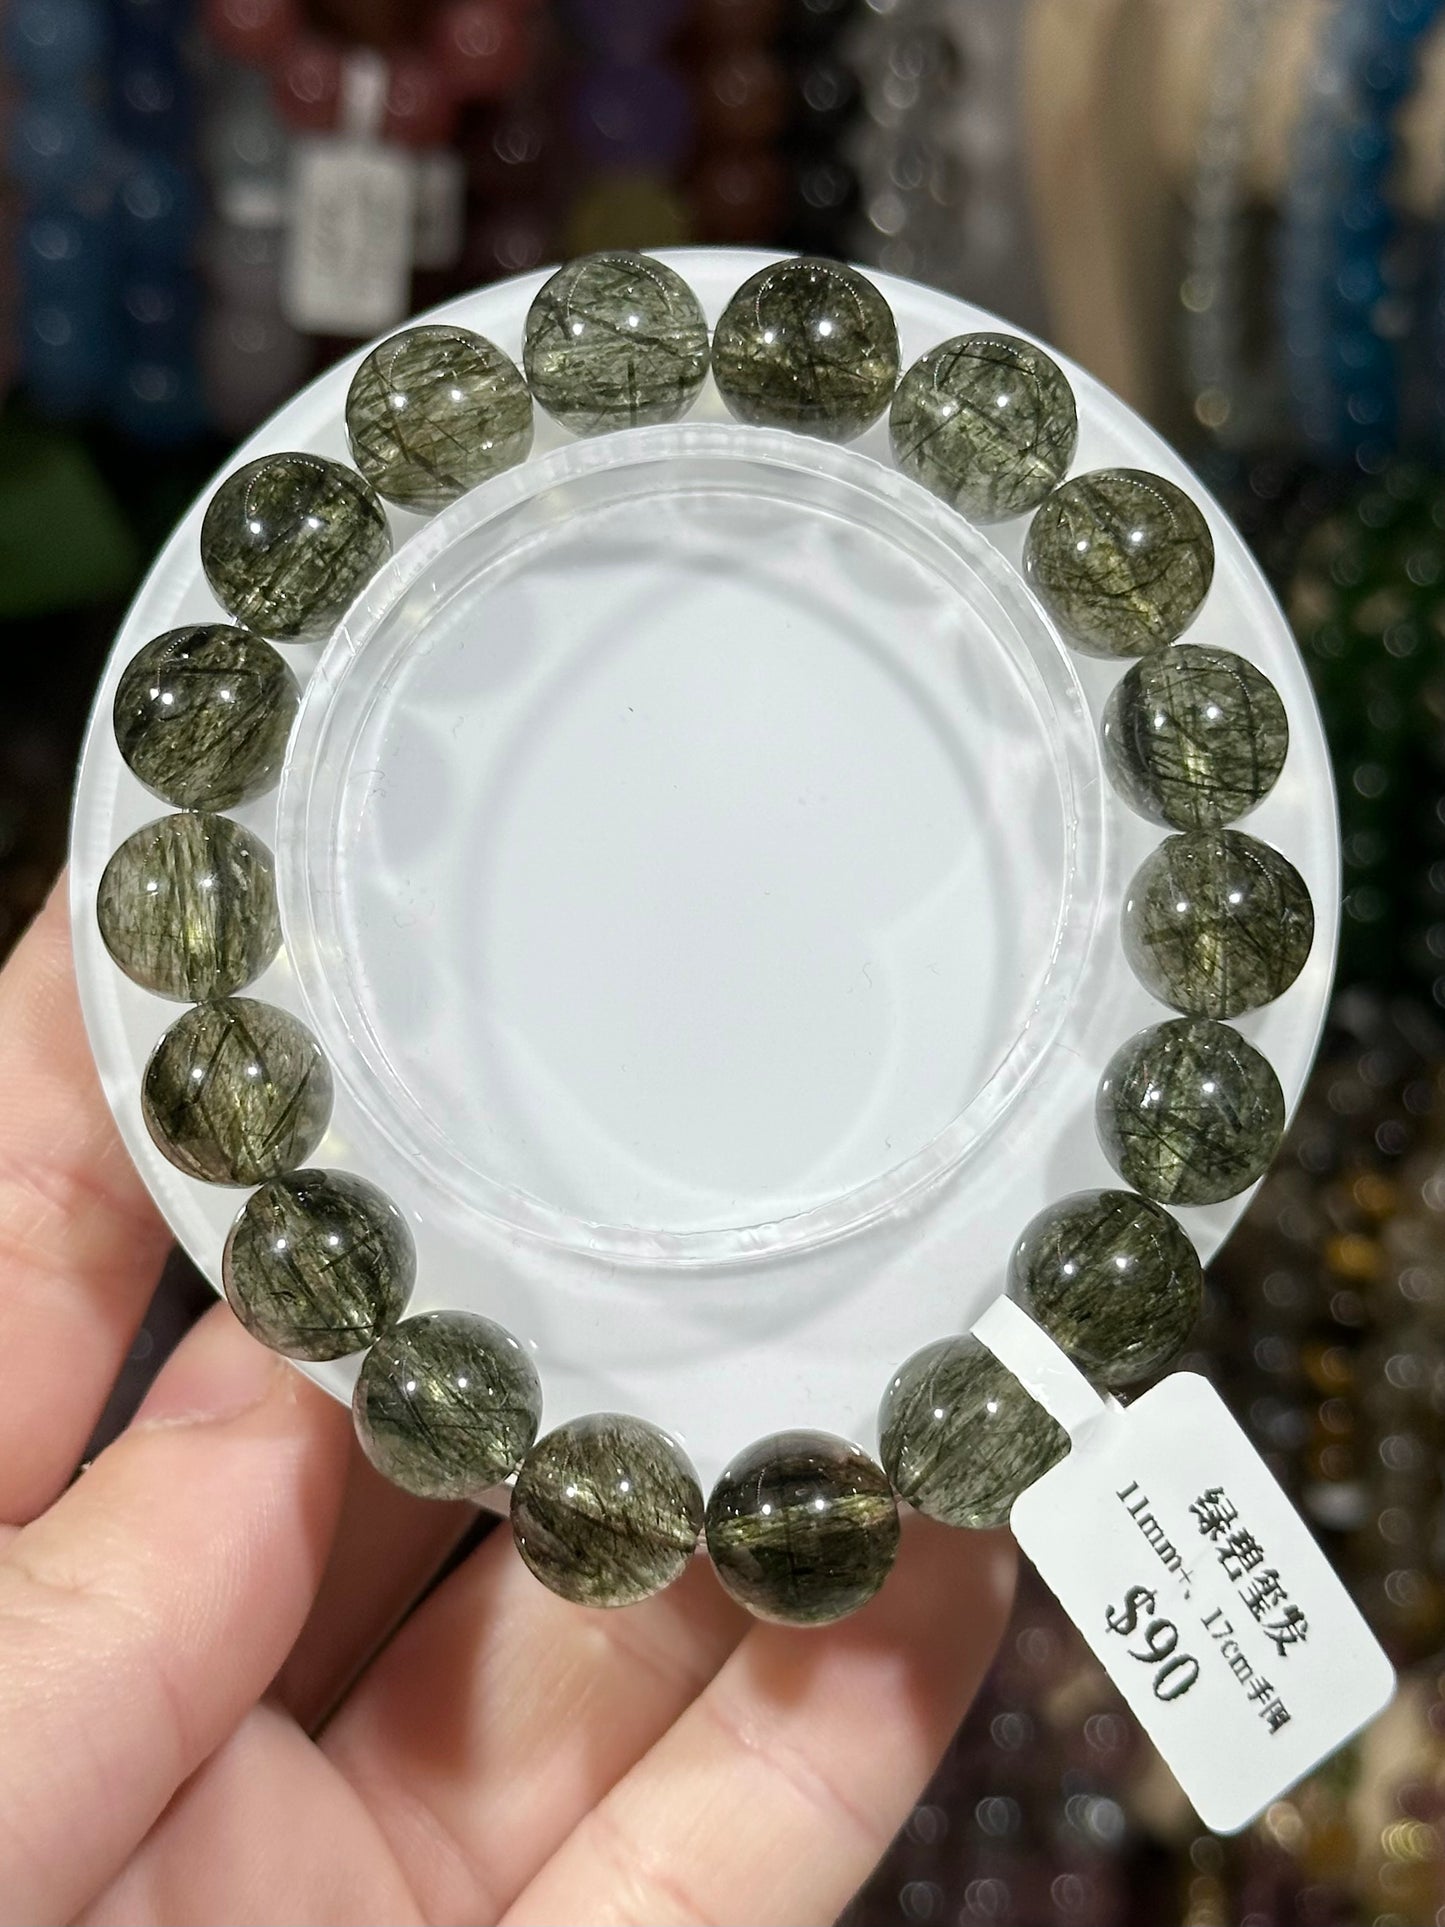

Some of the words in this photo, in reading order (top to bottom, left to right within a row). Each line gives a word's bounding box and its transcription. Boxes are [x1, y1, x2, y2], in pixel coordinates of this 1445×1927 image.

[1105, 1585, 1200, 1702] $90
[1188, 1486, 1309, 1658] 绿碧玺发
